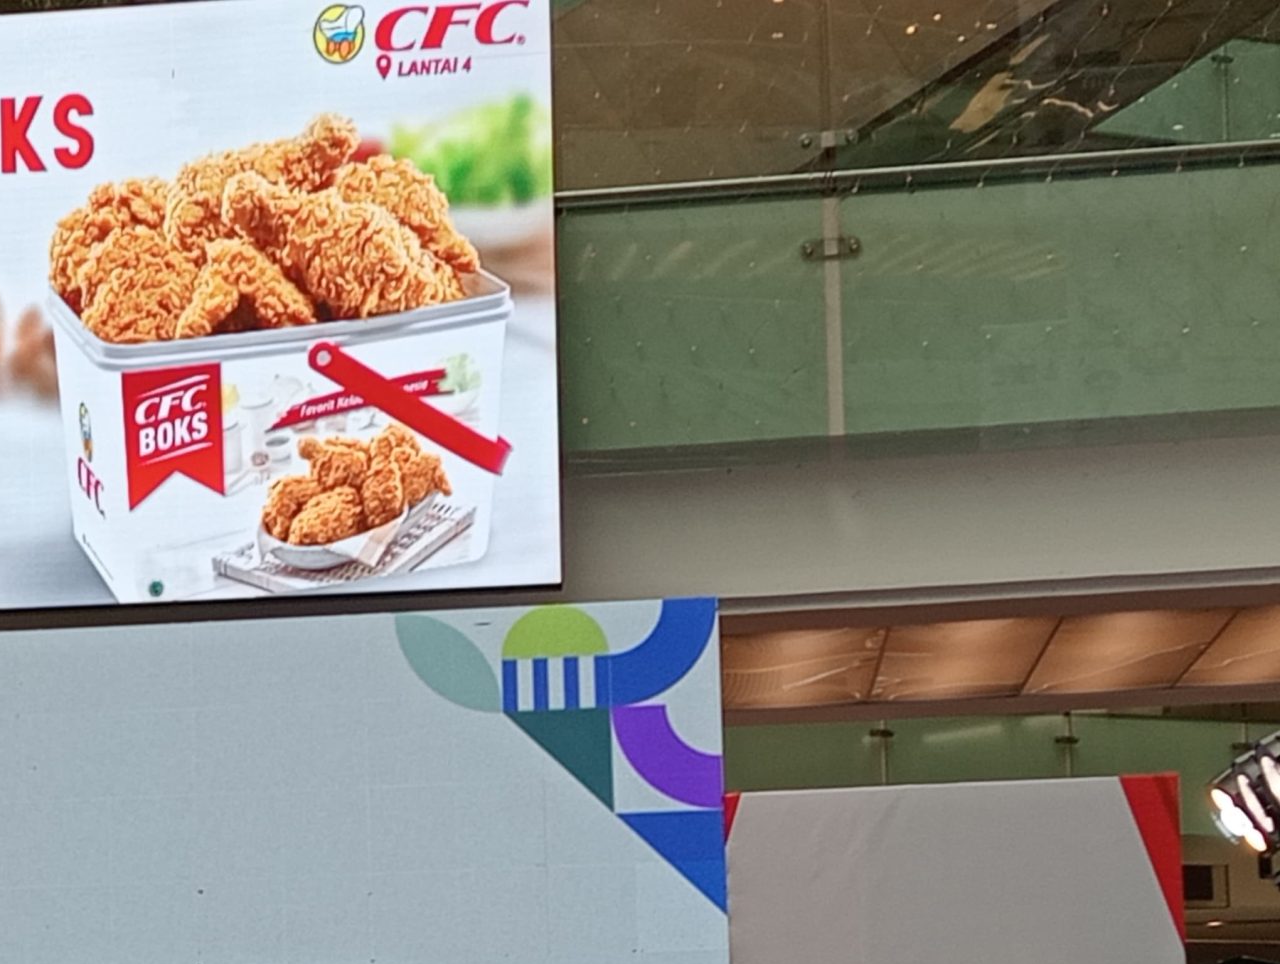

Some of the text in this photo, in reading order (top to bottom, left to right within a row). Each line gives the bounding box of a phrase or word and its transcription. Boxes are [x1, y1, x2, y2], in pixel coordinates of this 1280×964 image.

[375, 0, 529, 52] CFC
[397, 56, 473, 77] LANTAI 4
[134, 383, 208, 425] CFC
[138, 410, 209, 457] BOKS
[78, 456, 105, 518] CFC
